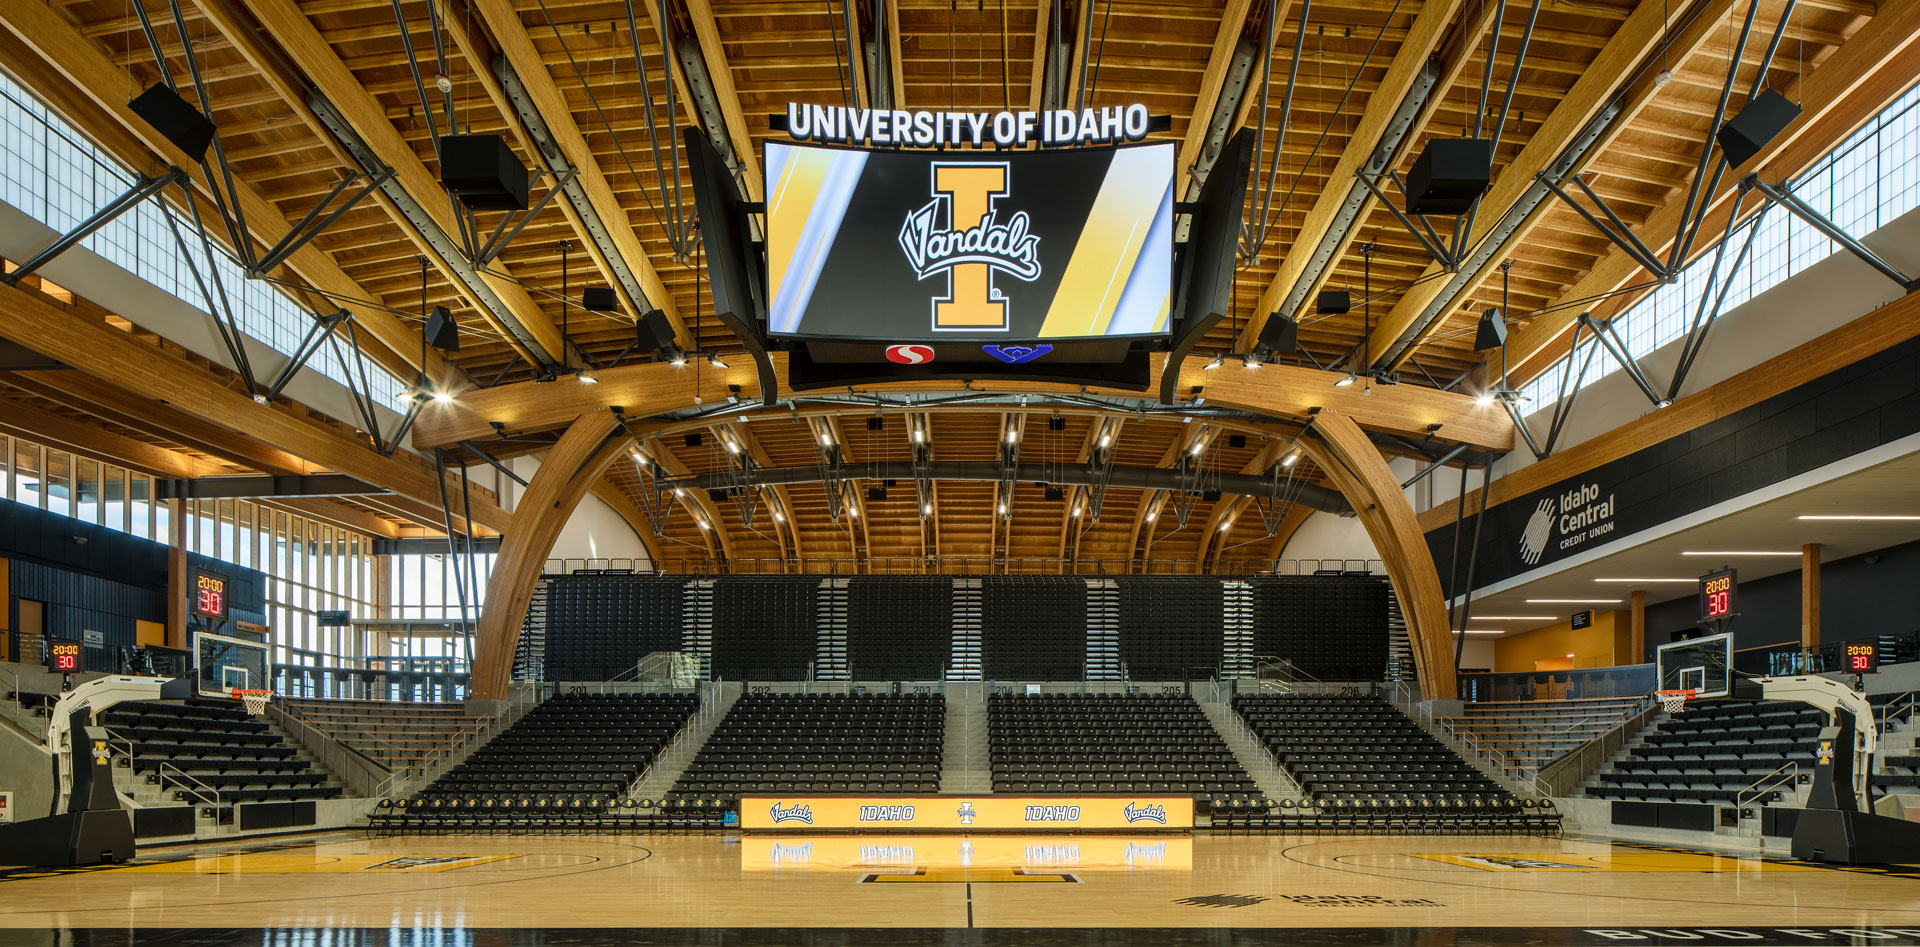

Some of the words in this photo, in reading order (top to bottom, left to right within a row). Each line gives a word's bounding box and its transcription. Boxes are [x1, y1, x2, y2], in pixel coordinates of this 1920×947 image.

[788, 101, 989, 145] UNIVERSITY
[993, 110, 1037, 144] OF
[1043, 103, 1148, 142] IDAHO
[898, 198, 1041, 282] Vandals
[1560, 483, 1600, 514] Idaho
[1559, 493, 1615, 535] Central
[1559, 531, 1588, 550] CREDIT
[1589, 520, 1615, 539] UNION
[198, 575, 223, 593] 20:00
[1705, 577, 1730, 595] 20:00
[201, 589, 221, 615] 30
[1708, 592, 1729, 616] 30
[53, 645, 78, 655] 20:00
[1847, 646, 1872, 656] 20:00
[59, 655, 74, 668] 30
[1853, 656, 1868, 669] 30
[570, 686, 587, 695] 201
[751, 686, 770, 695] 202
[913, 686, 931, 695] 203
[995, 686, 1014, 695] 204
[1163, 686, 1181, 695] 205
[1341, 686, 1360, 695] 206
[769, 801, 813, 825] Vandals
[859, 805, 915, 822] IDAHO
[1025, 805, 1081, 822] IDAHO
[1123, 801, 1167, 825] Vandals
[1583, 928, 1764, 940] BUD
